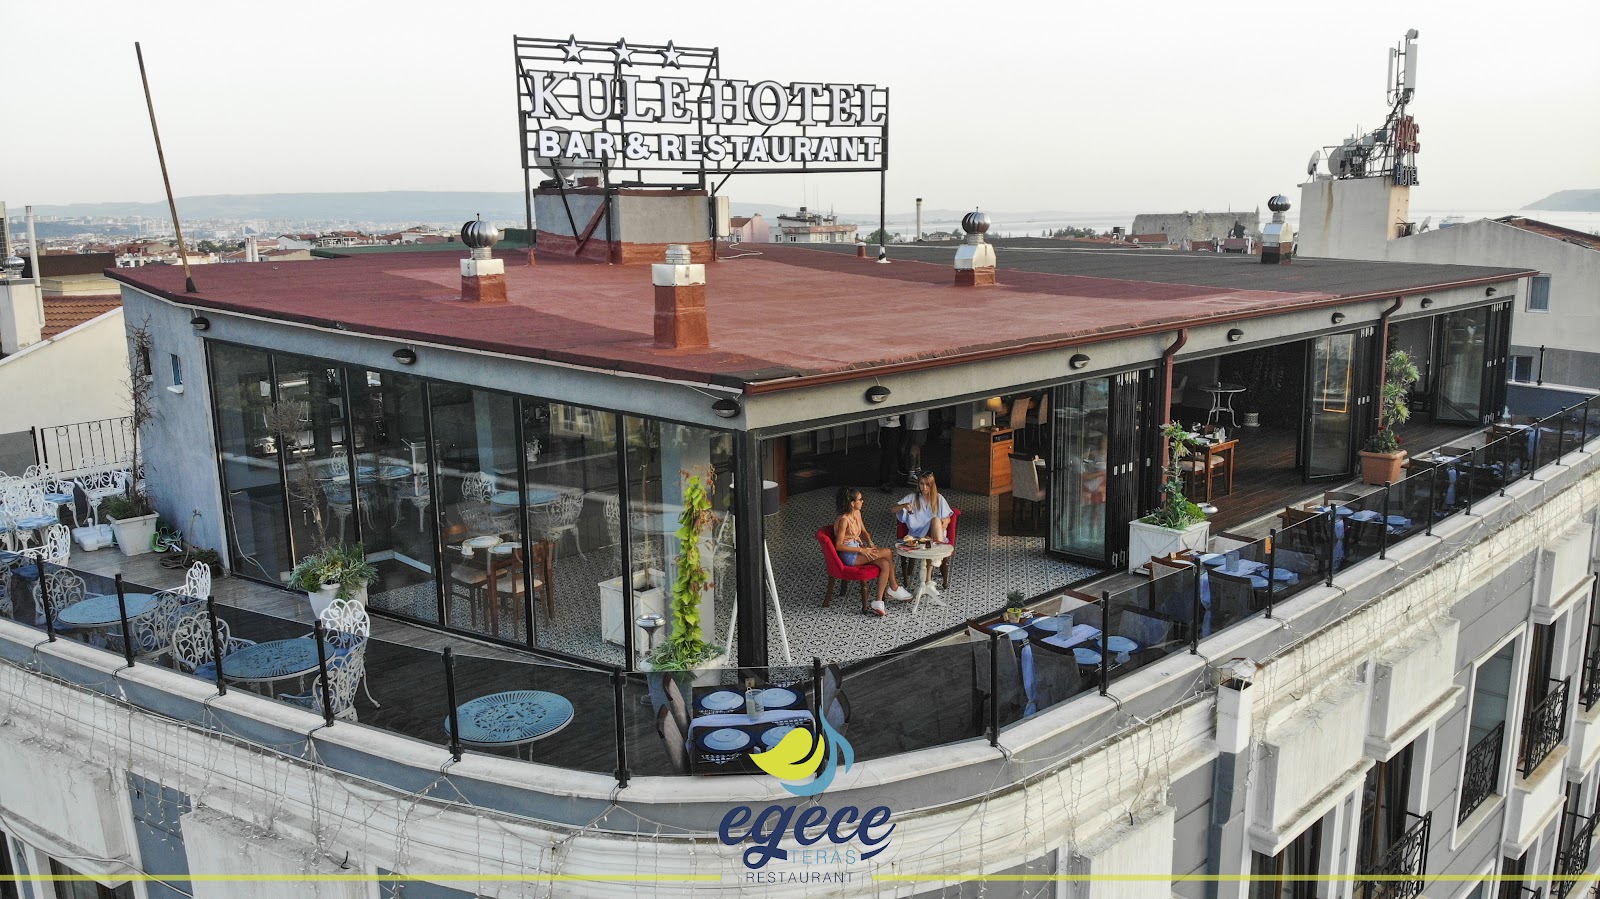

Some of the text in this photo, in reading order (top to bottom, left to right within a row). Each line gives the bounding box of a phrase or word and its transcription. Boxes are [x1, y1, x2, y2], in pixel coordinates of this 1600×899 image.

[525, 68, 886, 127] KULE HOTEL
[537, 129, 881, 162] BAR & RESTAURANT
